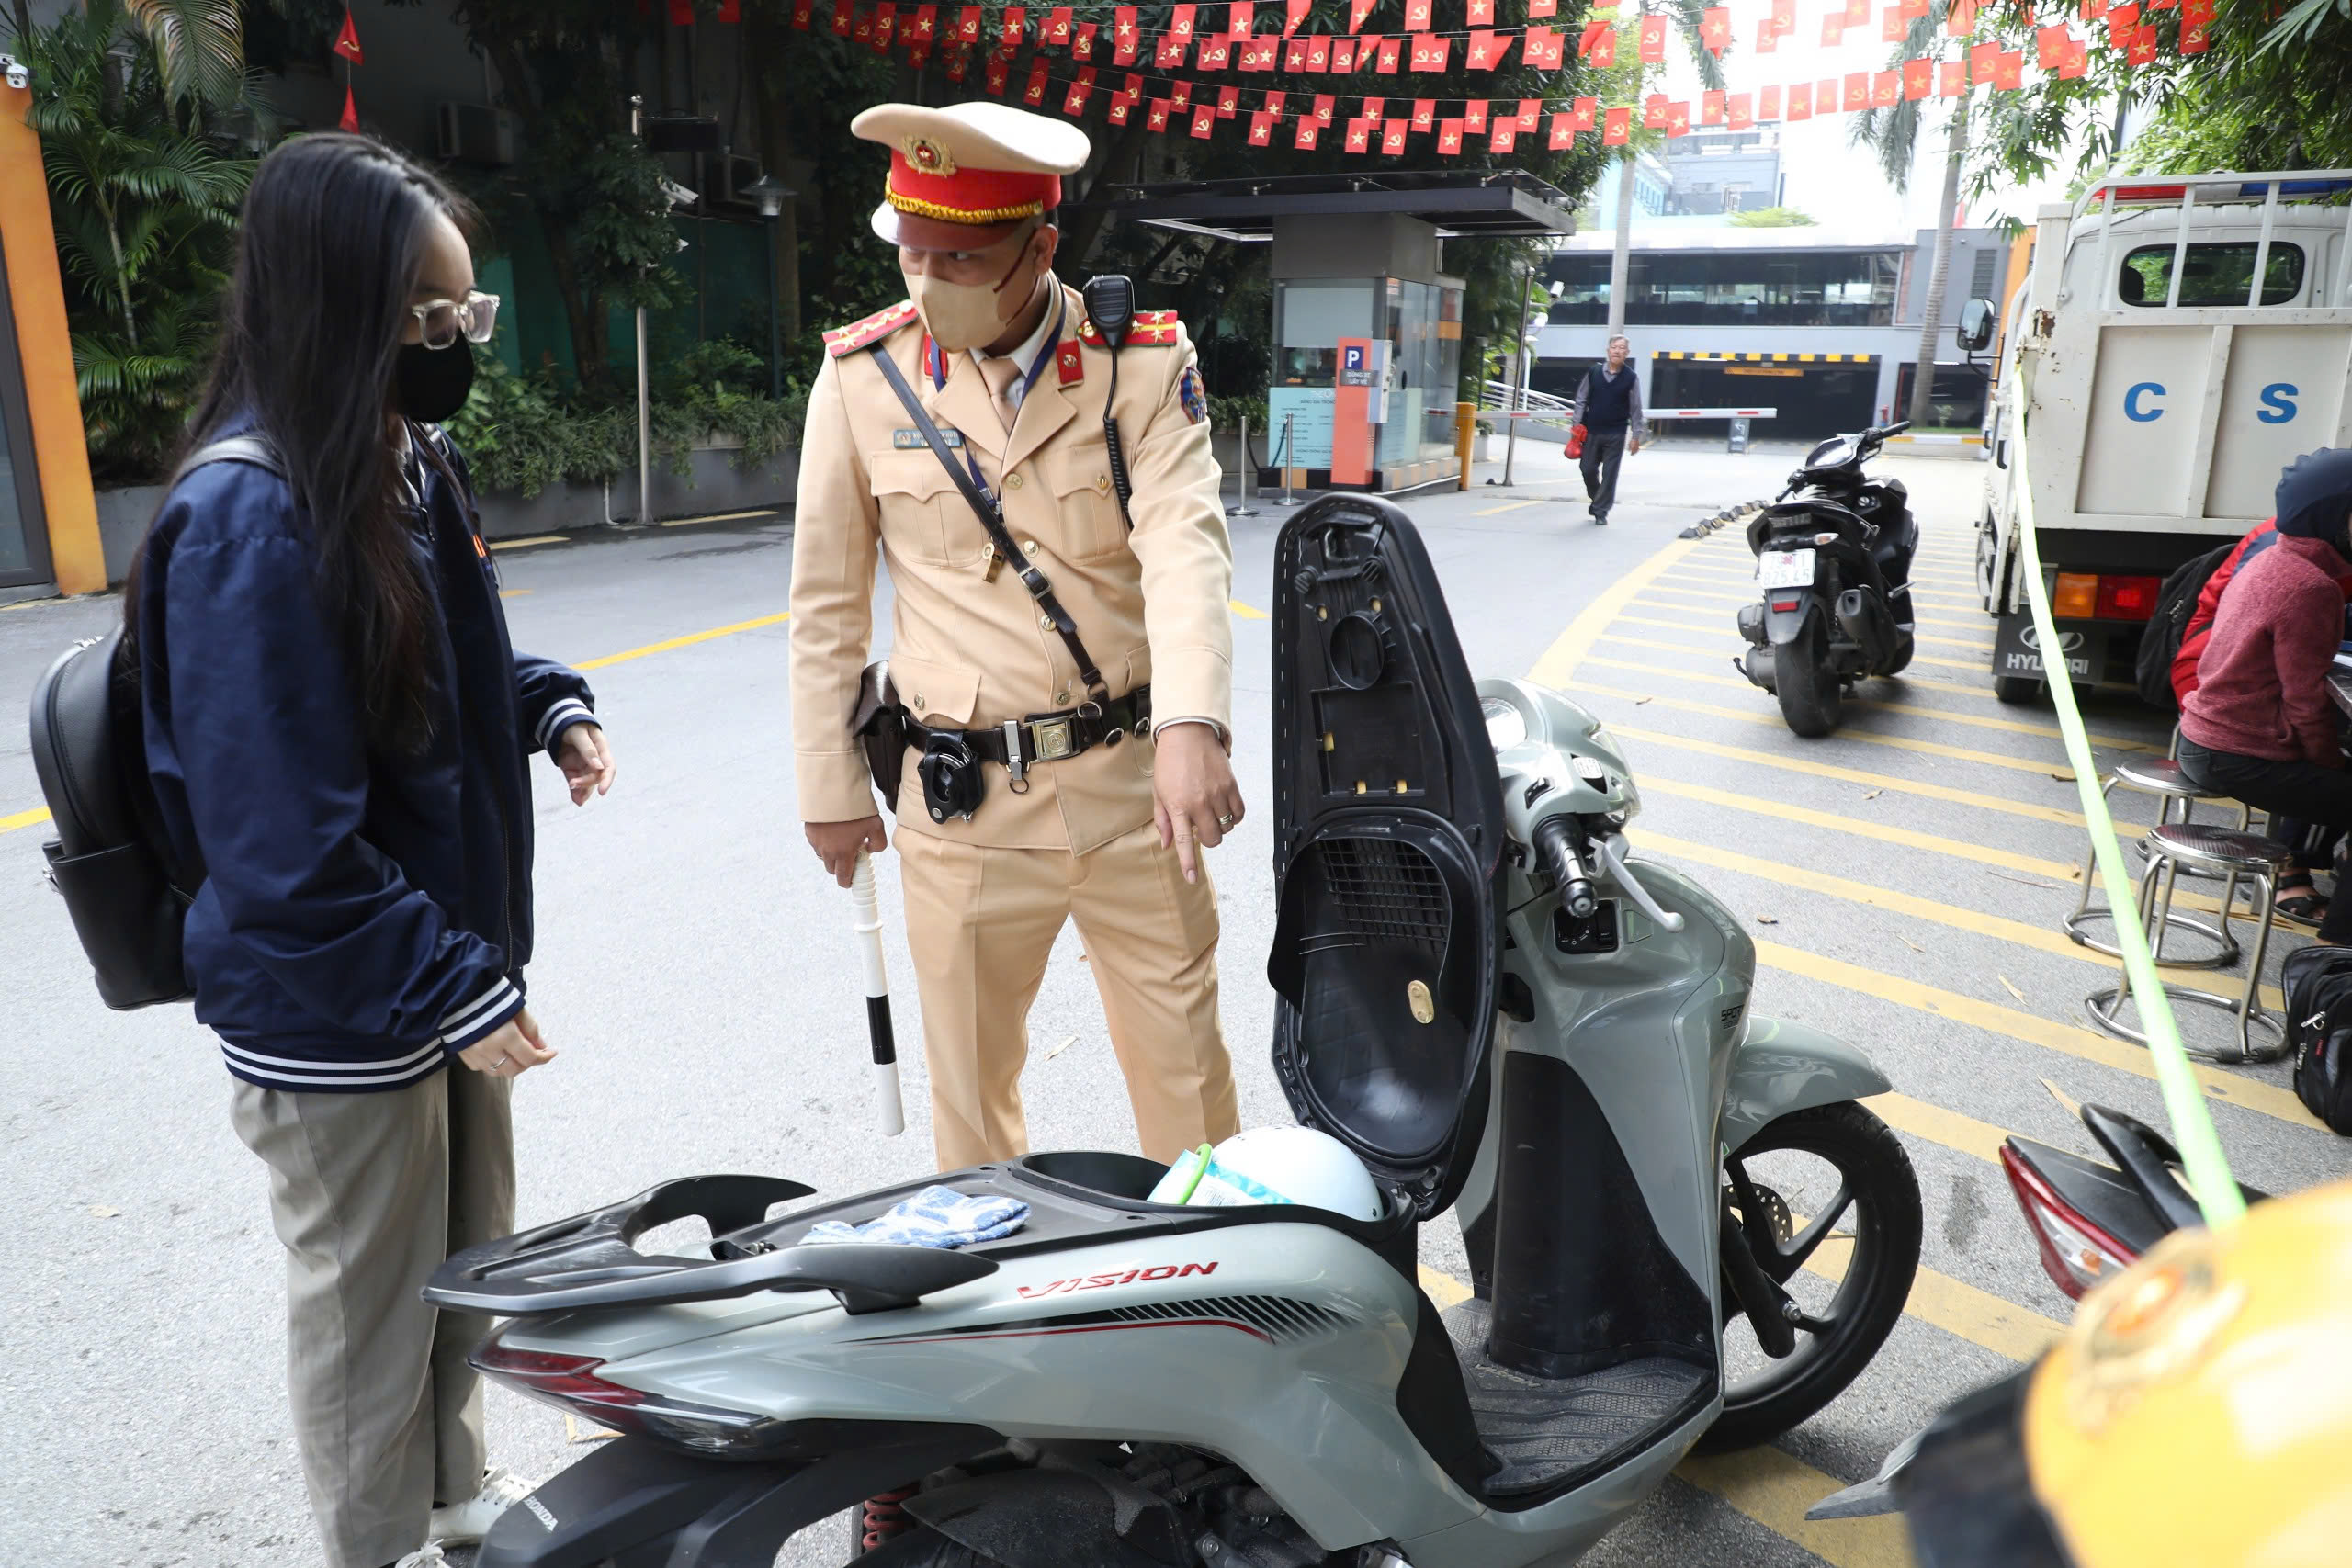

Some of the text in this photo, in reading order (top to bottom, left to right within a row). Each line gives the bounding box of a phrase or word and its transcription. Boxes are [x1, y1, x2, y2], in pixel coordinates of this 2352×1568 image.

[1347, 350, 1360, 367] P
[2123, 382, 2299, 424] C S
[2007, 653, 2090, 675] HYUAI
[1016, 1261, 1219, 1299] VISION
[523, 1495, 559, 1532] HONDA
